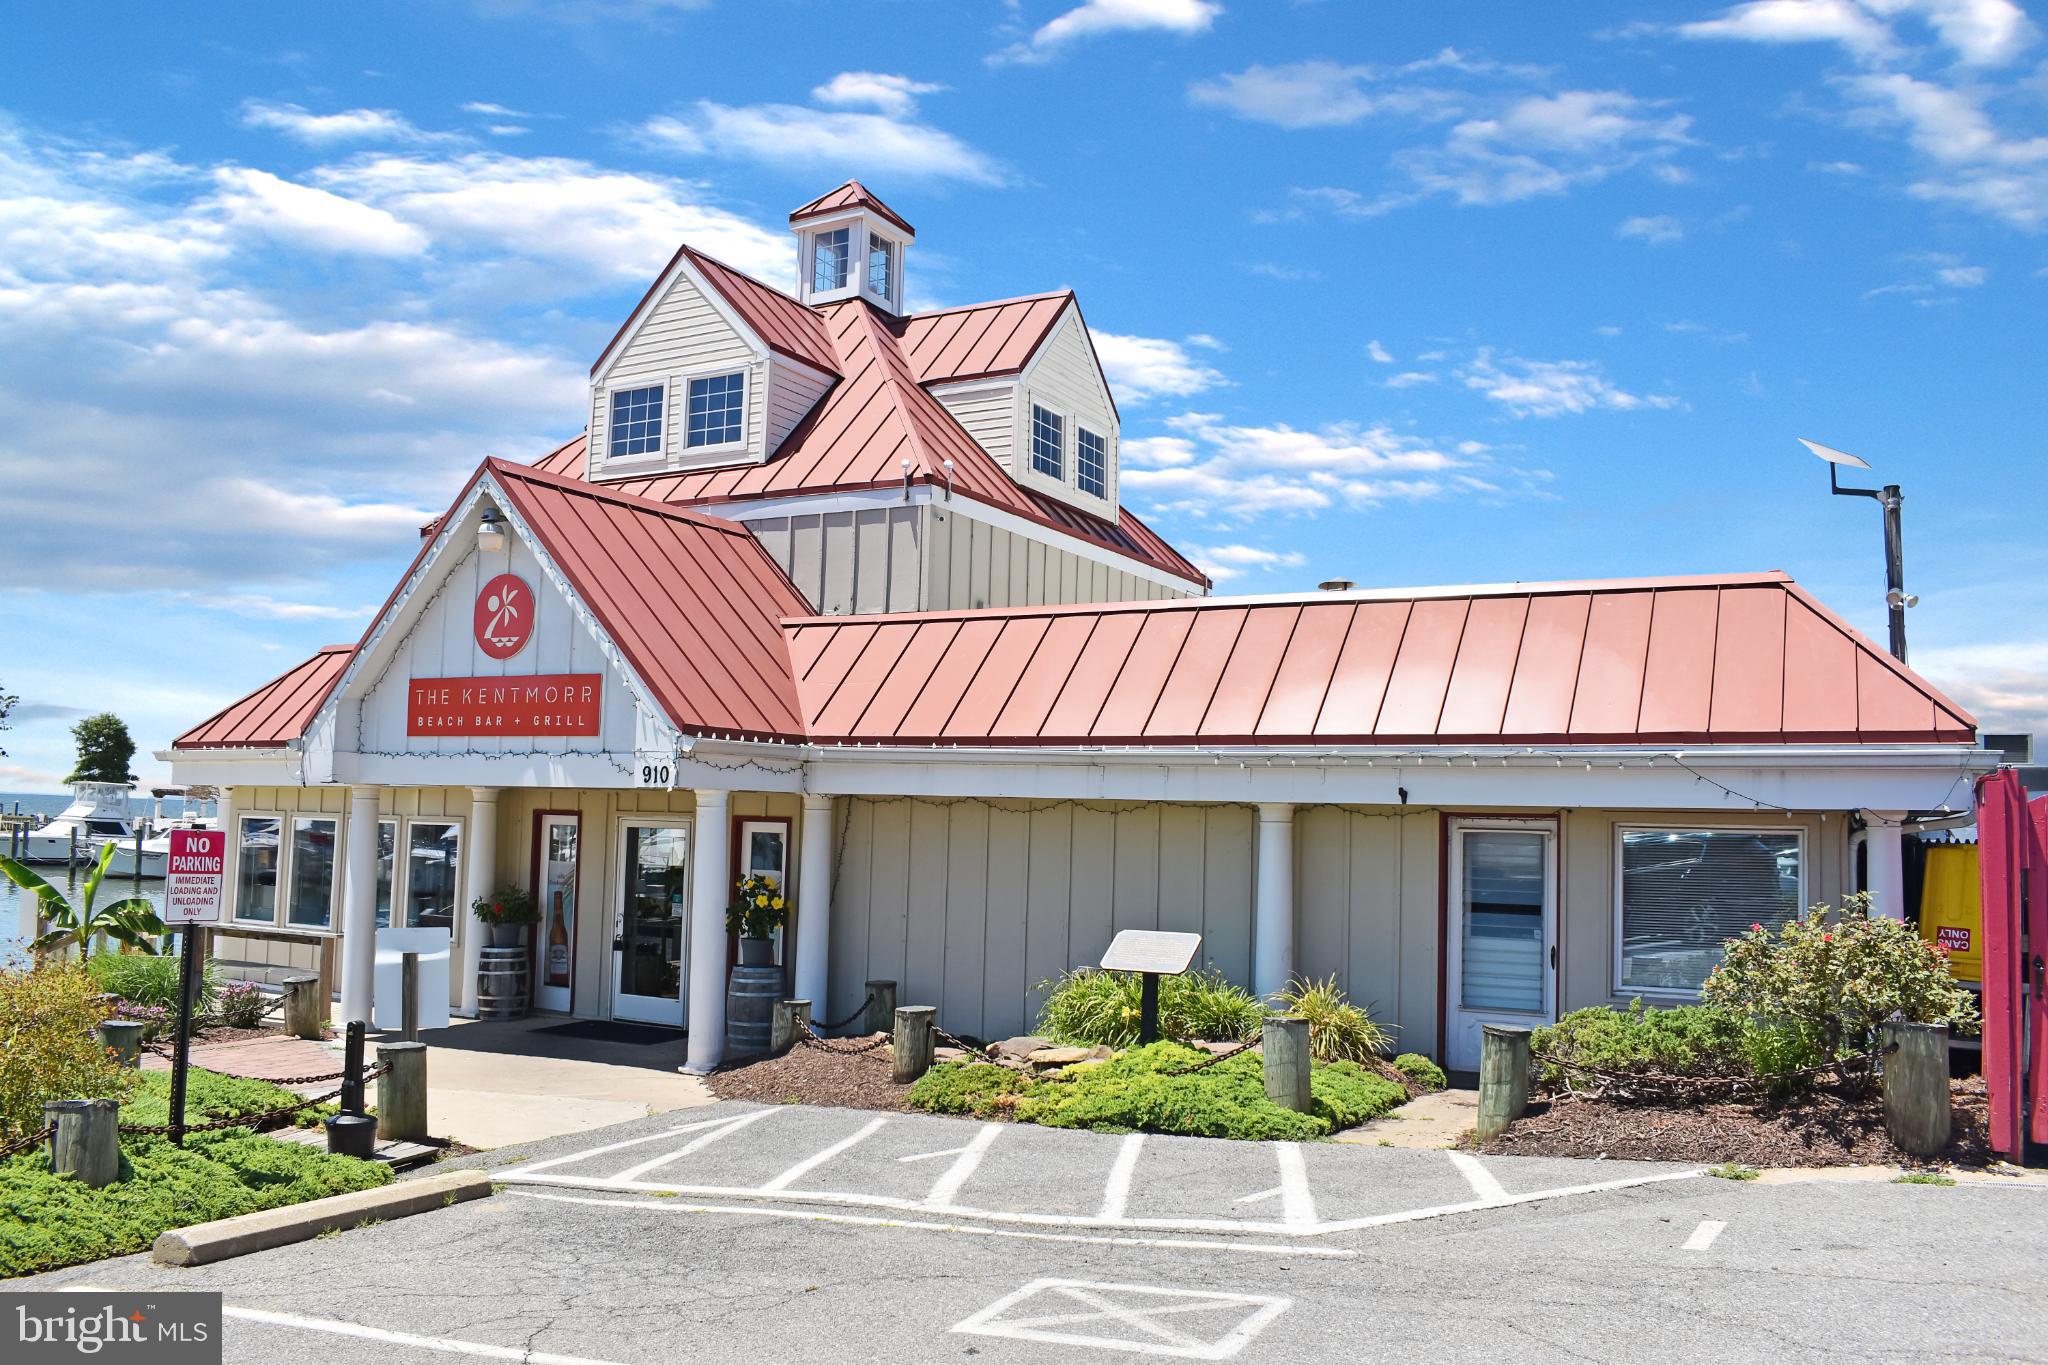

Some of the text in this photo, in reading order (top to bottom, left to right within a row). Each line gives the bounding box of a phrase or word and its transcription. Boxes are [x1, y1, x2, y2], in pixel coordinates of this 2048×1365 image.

[416, 686, 592, 705] THE KENTMORR
[417, 716, 463, 727] BEACH
[475, 715, 502, 727] BAR
[533, 715, 585, 726] GRILL
[642, 765, 669, 784] 910
[186, 837, 210, 853] NO
[172, 855, 221, 872] PARKING
[175, 876, 215, 885] IMMEDIATE
[170, 886, 218, 895] LOADING AND
[172, 897, 214, 906] UNLOADING
[183, 907, 202, 916] ONLY
[1939, 929, 1969, 939] ONLY
